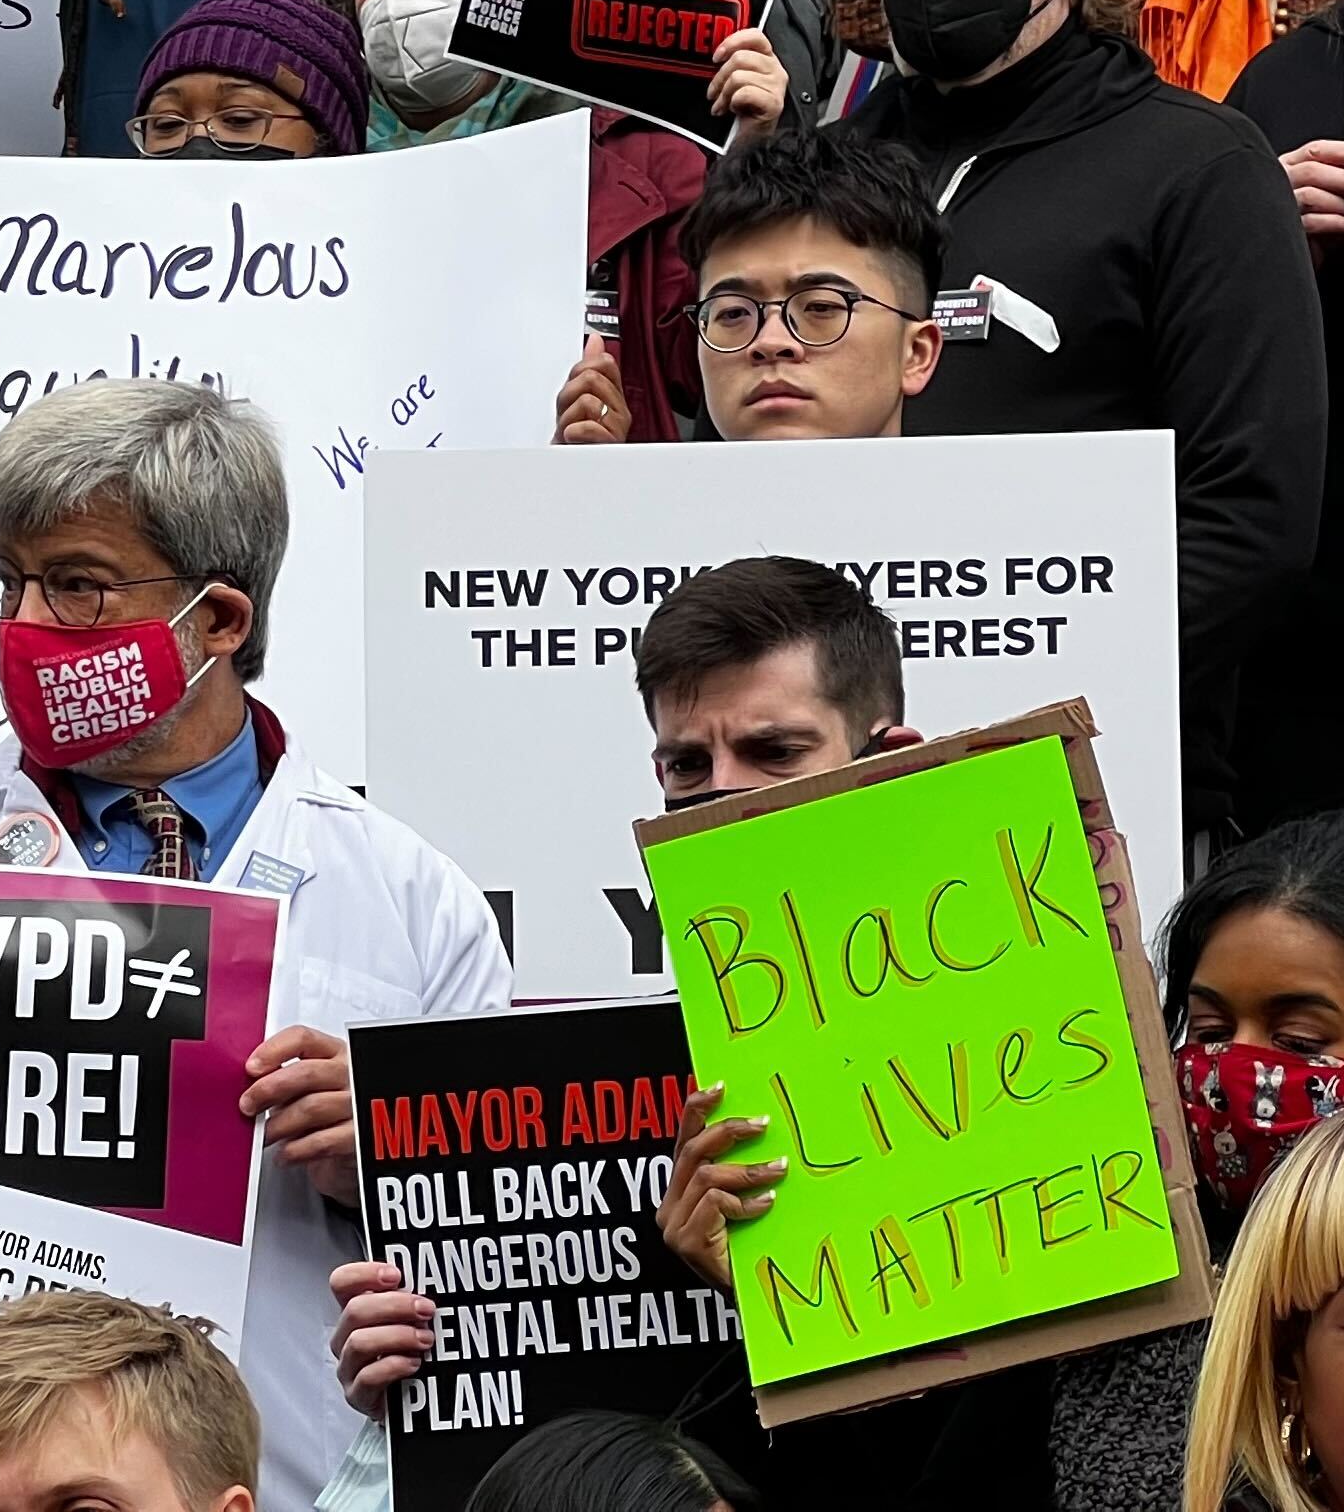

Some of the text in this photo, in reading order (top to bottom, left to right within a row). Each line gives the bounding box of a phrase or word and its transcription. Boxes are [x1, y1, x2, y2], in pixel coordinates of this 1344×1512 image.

[423, 568, 550, 609] NEW
[1006, 555, 1114, 597] FOR
[36, 641, 142, 687] RACISM
[472, 628, 577, 668] THE
[46, 680, 151, 724] HEALTH
[53, 663, 146, 703] PUBLIC
[51, 704, 155, 743] CRISIS.
[370, 1086, 546, 1160] MAYOR
[377, 1160, 611, 1231] ROLL BACK
[32, 1240, 106, 1284] ADAMS,
[756, 1150, 1164, 1346] MATTER
[401, 1370, 525, 1433] PLAN!
